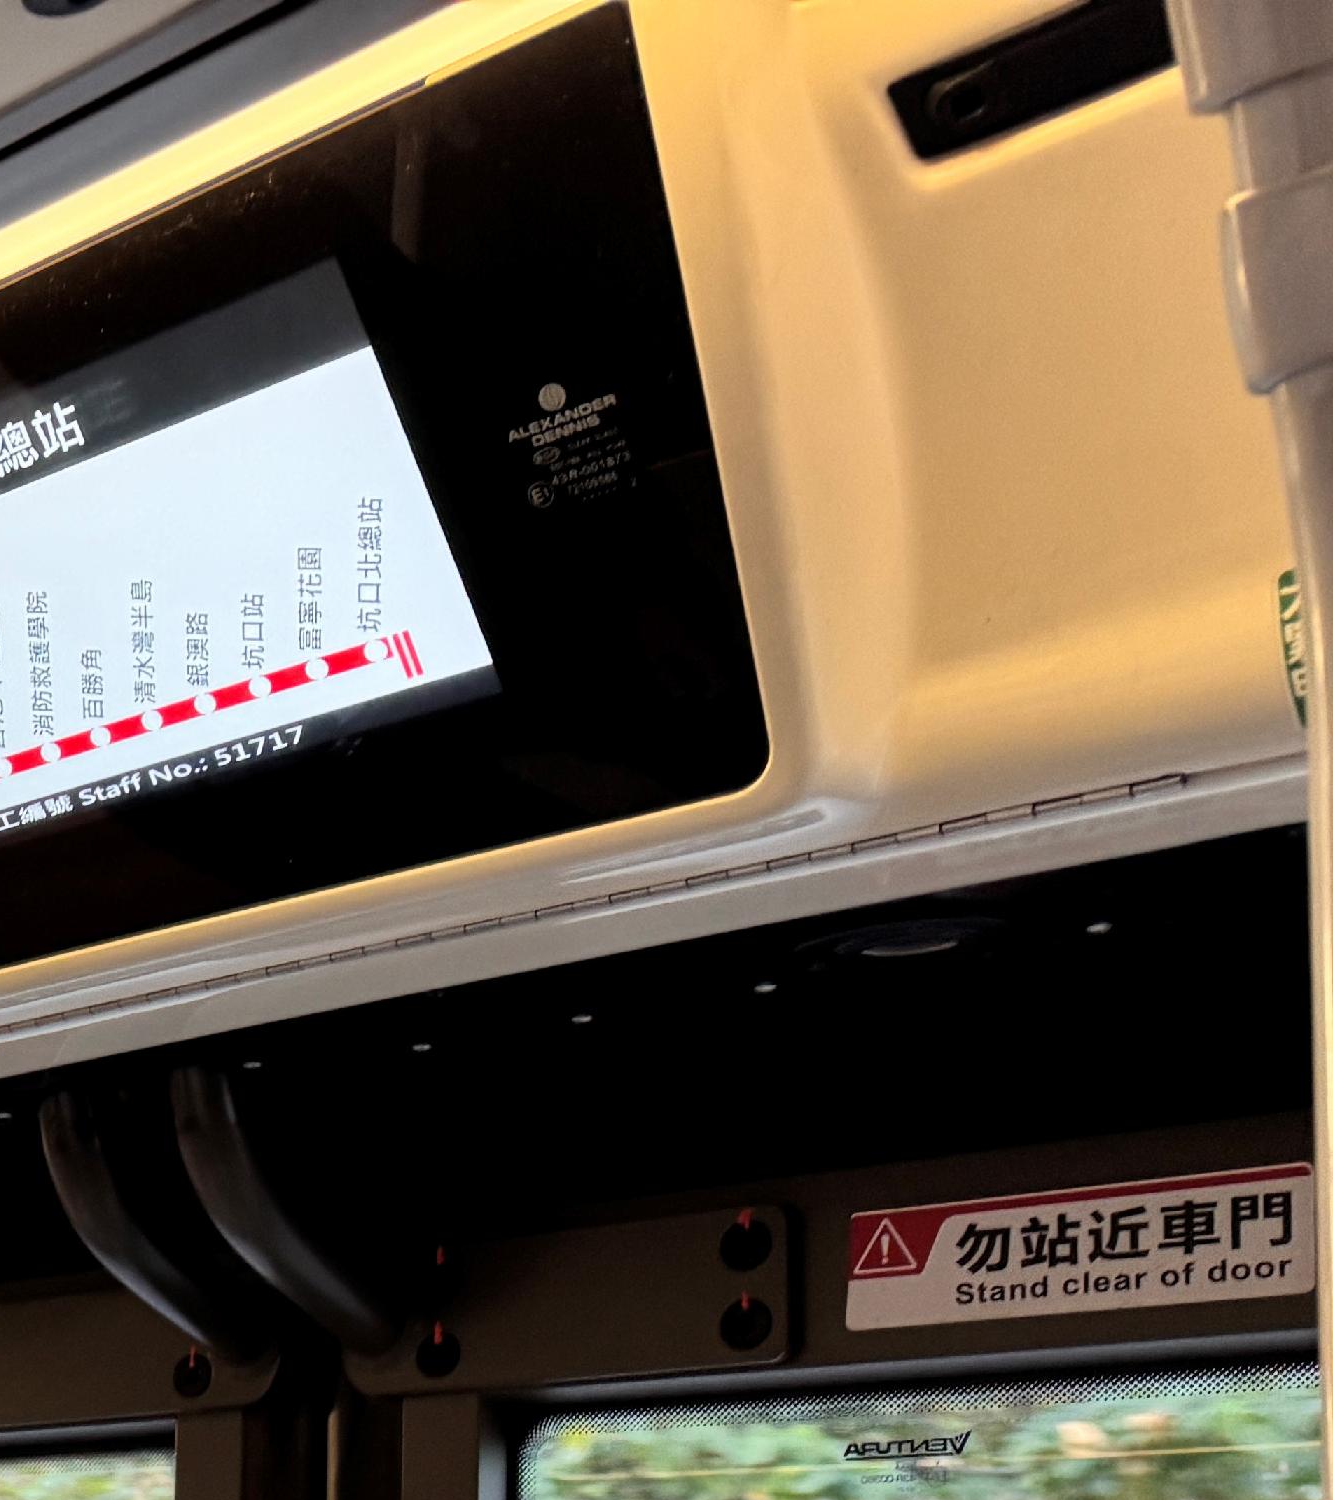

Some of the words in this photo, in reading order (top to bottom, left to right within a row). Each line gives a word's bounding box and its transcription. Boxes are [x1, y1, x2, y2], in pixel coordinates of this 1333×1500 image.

[508, 393, 617, 443] ALEXANDER
[531, 414, 601, 447] DENNIS
[297, 547, 322, 650] 富寧花園
[357, 496, 384, 633] 坑口北總站
[26, 591, 54, 736] 消防救護學院
[131, 579, 156, 704] 清水灣半島
[186, 611, 210, 687] 銀澳路
[240, 593, 264, 670] 坑口站
[81, 649, 105, 720] 百勝角
[80, 772, 142, 806] Staff
[148, 756, 209, 783] No.:
[213, 724, 305, 767] 51717
[955, 1191, 1293, 1275] 勿站近車門
[955, 1276, 1049, 1306] Stand
[1062, 1268, 1148, 1296] clear
[1160, 1261, 1195, 1288] of
[1207, 1256, 1293, 1282] door
